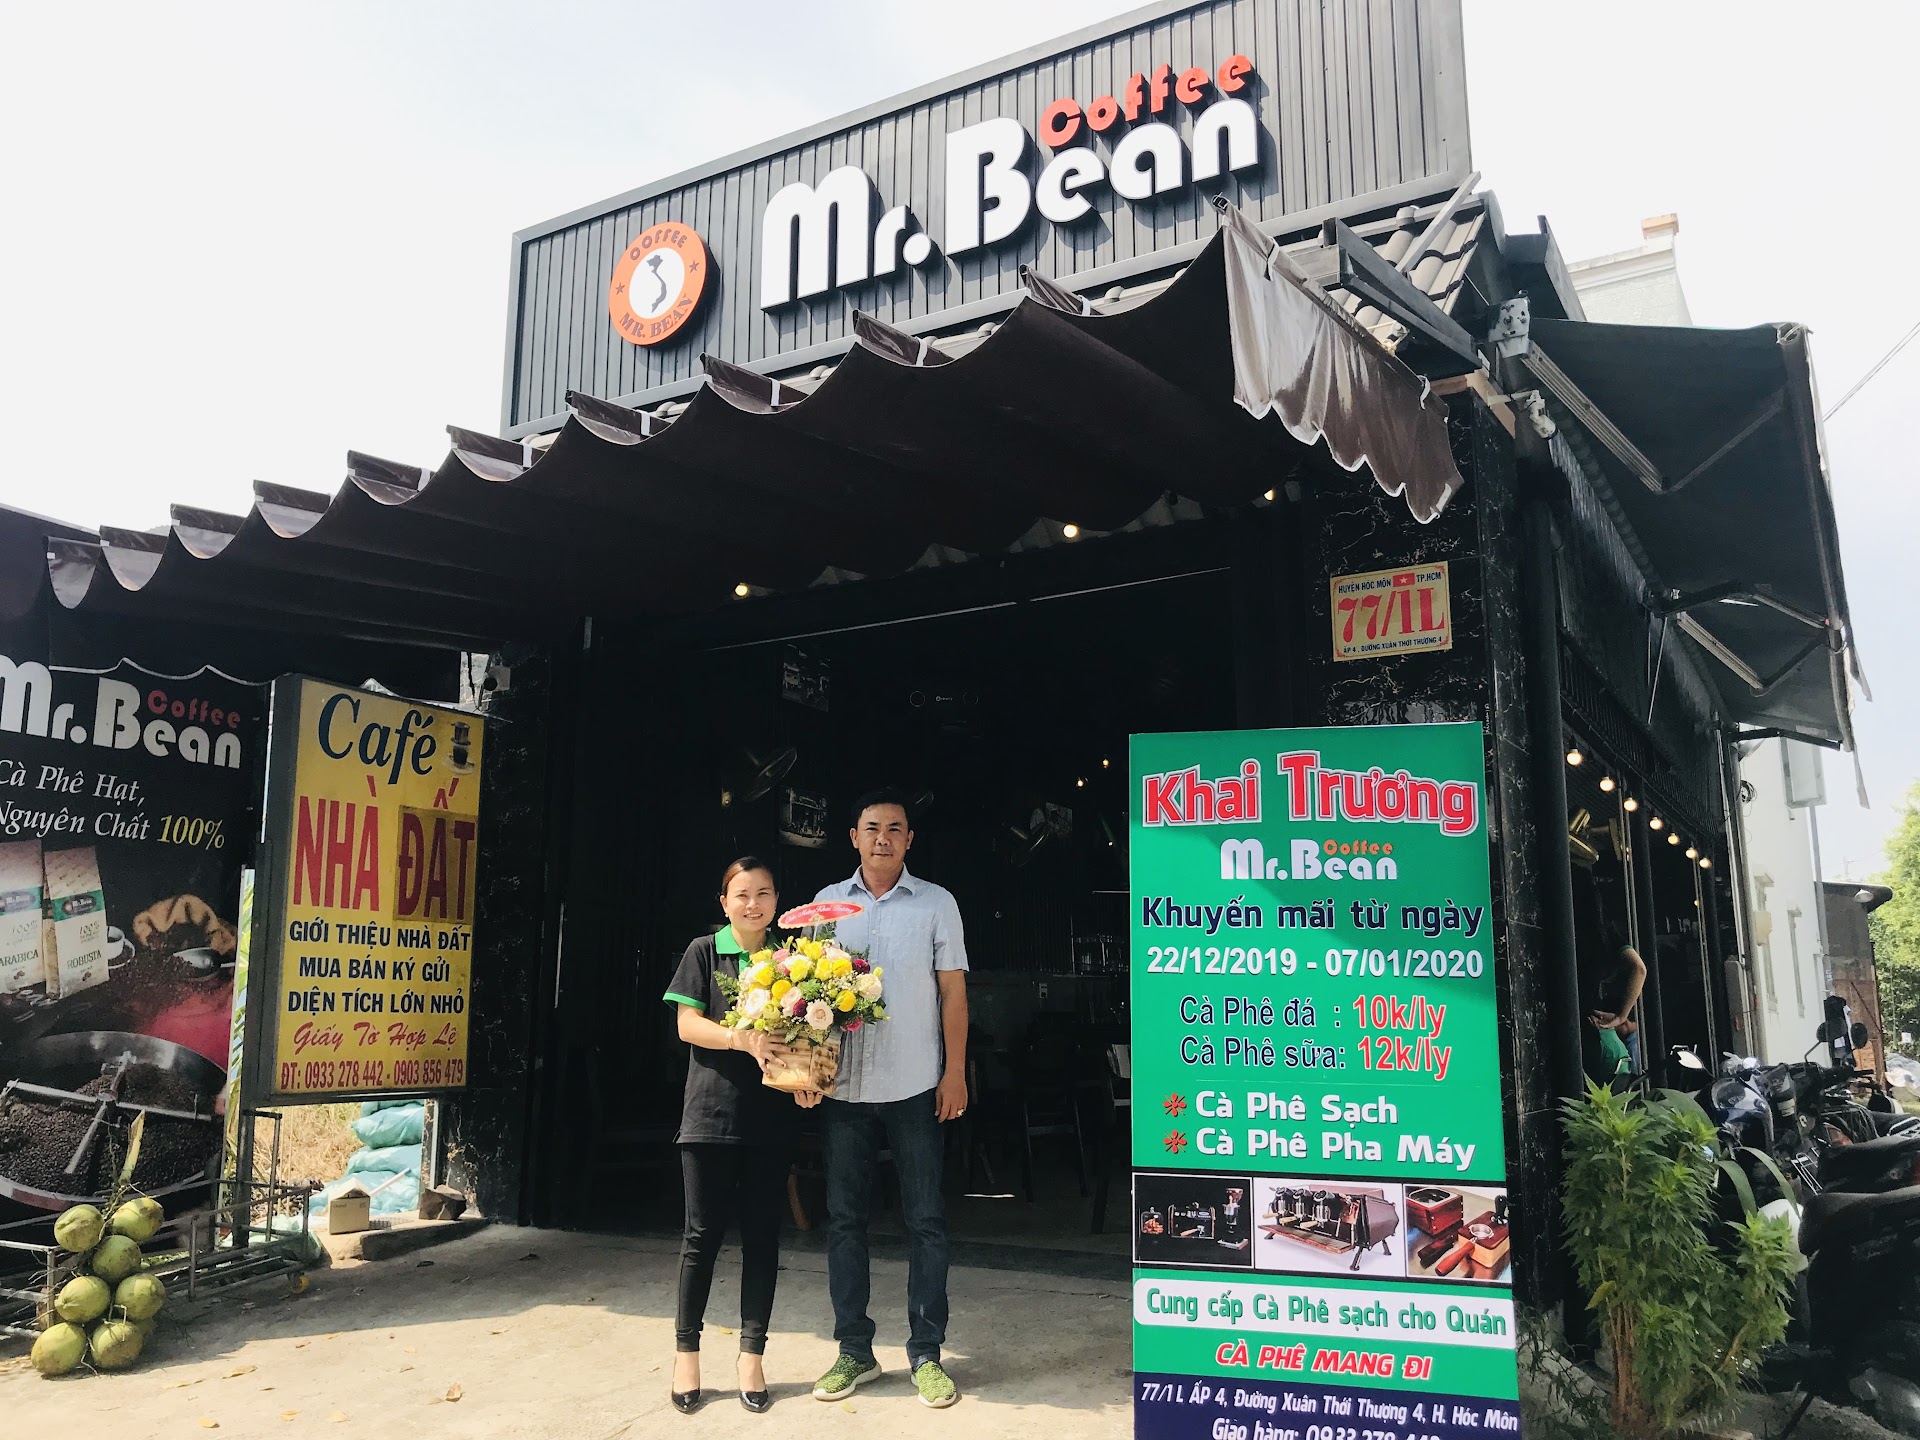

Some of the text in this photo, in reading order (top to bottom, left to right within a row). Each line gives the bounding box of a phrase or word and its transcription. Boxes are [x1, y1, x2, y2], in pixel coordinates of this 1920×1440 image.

[1039, 54, 1252, 147] Coffee
[761, 98, 1259, 310] Mr. Bean
[619, 293, 692, 338] MR. BEAN
[1416, 571, 1441, 583] TP.HCM
[0, 654, 241, 769] Mr. Bean
[147, 690, 241, 729] Coffee
[318, 693, 437, 785] Café
[0, 759, 145, 807] Cà Phê Hạt,
[1142, 750, 1479, 837] Khai Trương
[0, 800, 225, 850] Nguyên Chất 100%
[1323, 839, 1394, 855] Coffee
[293, 775, 475, 920] NHÀ ĐẤT
[1220, 838, 1398, 880] Mr. Bean
[290, 917, 471, 951] GIỚI THIỆU NHÀ ĐẤT
[1142, 894, 1484, 938] Khuyến mãi từ ngày
[67, 949, 102, 970] ROBUSTA
[299, 954, 450, 982] MUA BÁN KÝ GỬI
[1147, 946, 1483, 978] 22/12/2019 - 07/01/2020
[288, 986, 464, 1016] DIỆN TÍCH LỚN NHỎ
[1179, 994, 1446, 1039] Cà Phê đá : 10k/ly
[293, 1021, 457, 1055] Giấy Tờ Hợp Lệ
[1180, 1035, 1452, 1080] Cà Phê sữa: 12k/ly
[281, 1062, 301, 1090] ĐT:
[305, 1061, 334, 1089] 0933
[337, 1060, 360, 1088] 278
[362, 1060, 383, 1087] 442
[393, 1060, 419, 1085] 0903
[422, 1059, 442, 1084] 856
[444, 1058, 464, 1083] 479
[1195, 1091, 1398, 1129] Cà Phê Sạch
[1196, 1127, 1476, 1172] Cà Phê Pha Máy
[1147, 1288, 1506, 1335] Cung cấp Cà Phê sạch cho Quán
[1215, 1338, 1433, 1380] CÀ PHÊ MANG ĐI
[1188, 1380, 1211, 1404] ẤP
[1214, 1387, 1228, 1408] 4,
[1234, 1388, 1277, 1415] Đường
[1281, 1392, 1317, 1413] Xuân
[1323, 1395, 1352, 1416] Thới
[1357, 1397, 1408, 1425] Thượng
[1412, 1402, 1426, 1424] 4,
[1431, 1404, 1446, 1424] H.
[1451, 1405, 1478, 1427] Hóc
[1483, 1408, 1519, 1431] Môn
